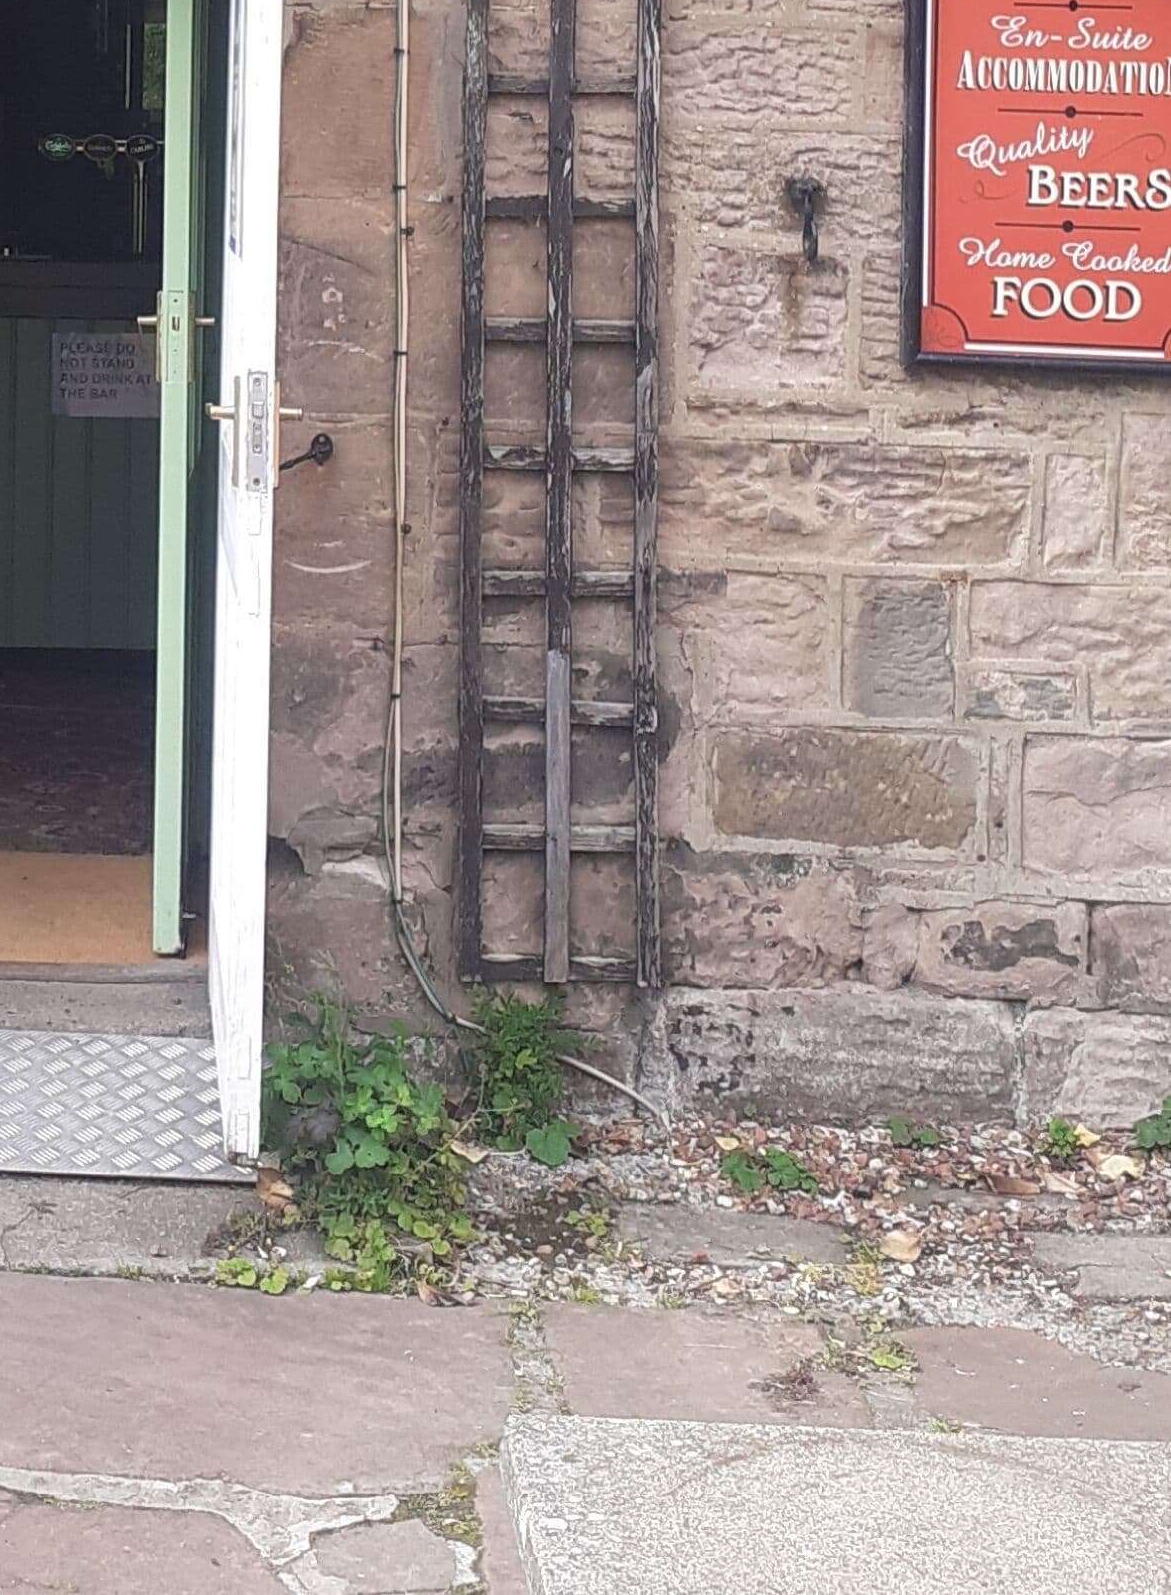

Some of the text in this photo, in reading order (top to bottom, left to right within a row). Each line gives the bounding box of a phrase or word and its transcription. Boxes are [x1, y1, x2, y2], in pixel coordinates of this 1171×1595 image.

[991, 15, 1153, 51] En-Suite
[957, 121, 1094, 177] Quality
[1027, 164, 1171, 210] BEERS
[958, 237, 1171, 273] Home Cooked
[992, 276, 1142, 321] FOOD
[59, 342, 135, 354] PLEASE DO
[59, 358, 135, 369] NOT STAND
[59, 388, 118, 399] THE BAR
[60, 373, 151, 384] AND DRINK AT
